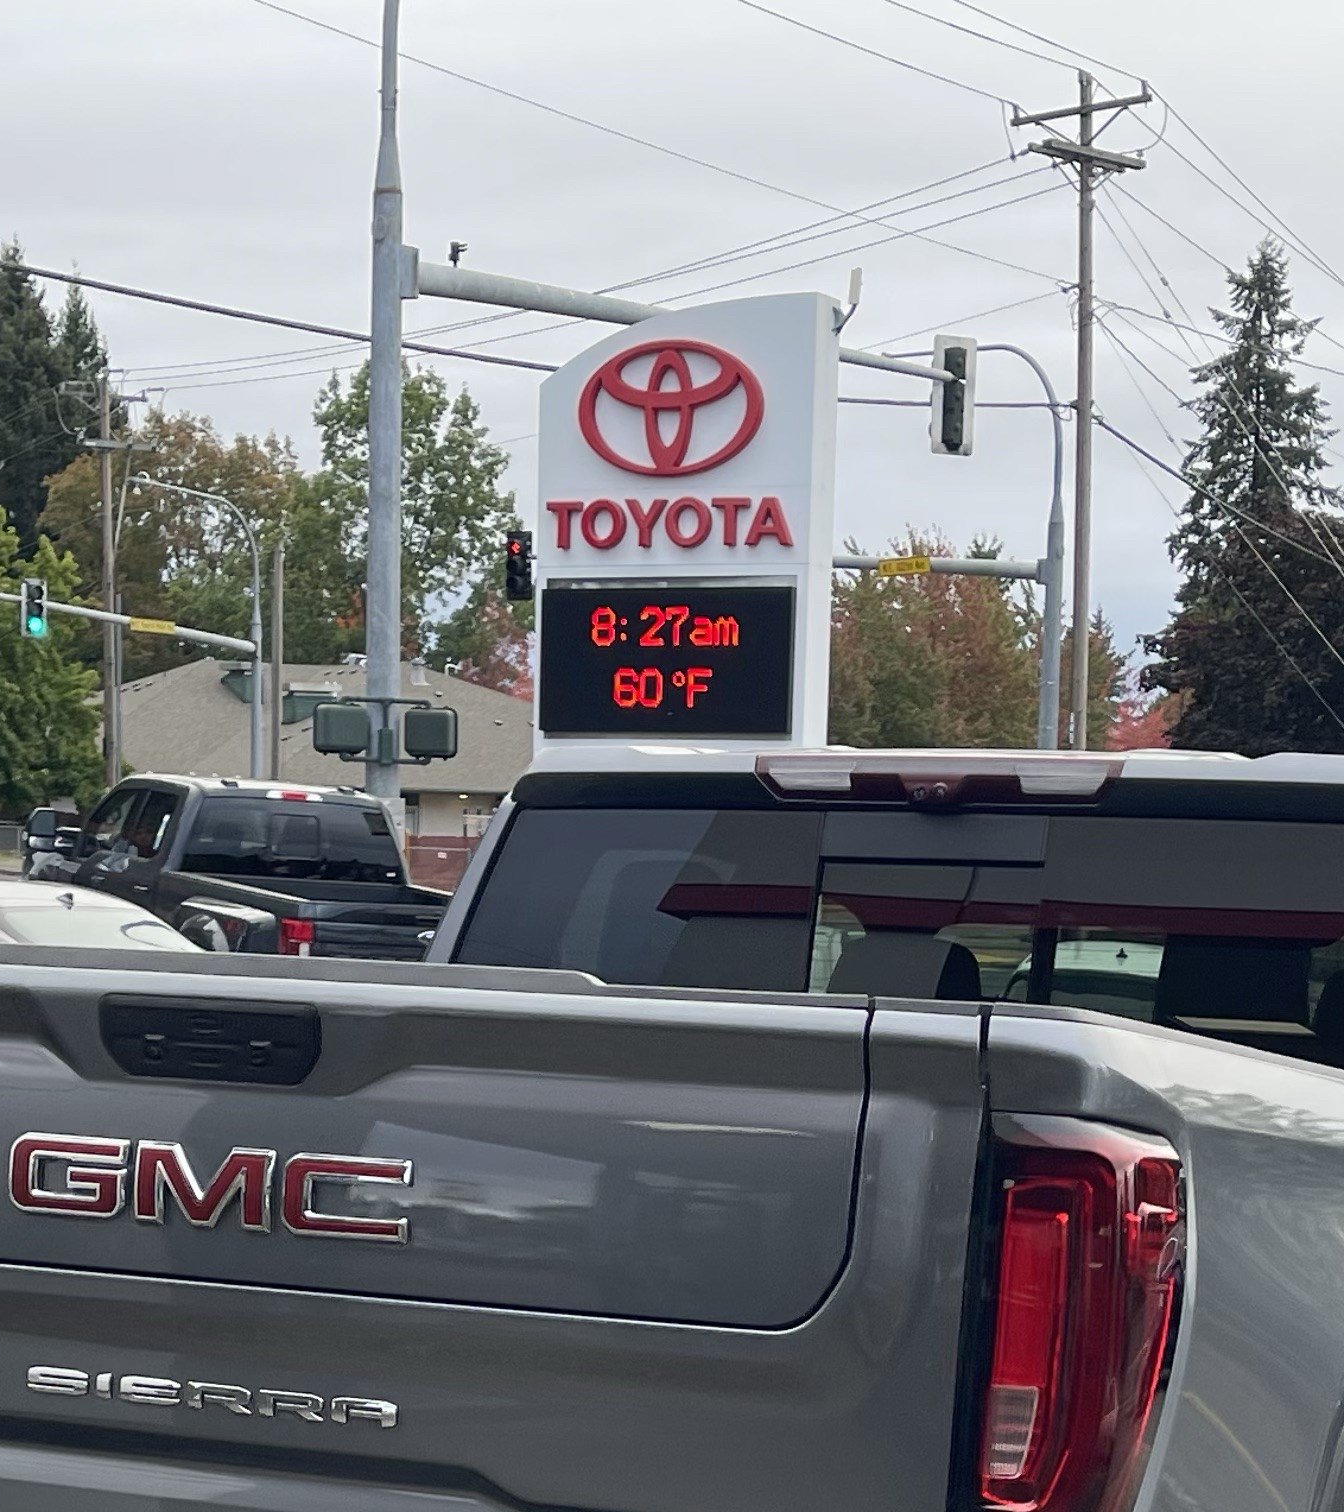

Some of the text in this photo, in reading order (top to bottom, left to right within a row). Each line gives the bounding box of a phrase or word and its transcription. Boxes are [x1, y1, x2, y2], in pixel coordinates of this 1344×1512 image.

[546, 496, 794, 551] TOYOTA
[9, 1131, 414, 1244] GMC
[26, 1364, 400, 1428] SIERRA
